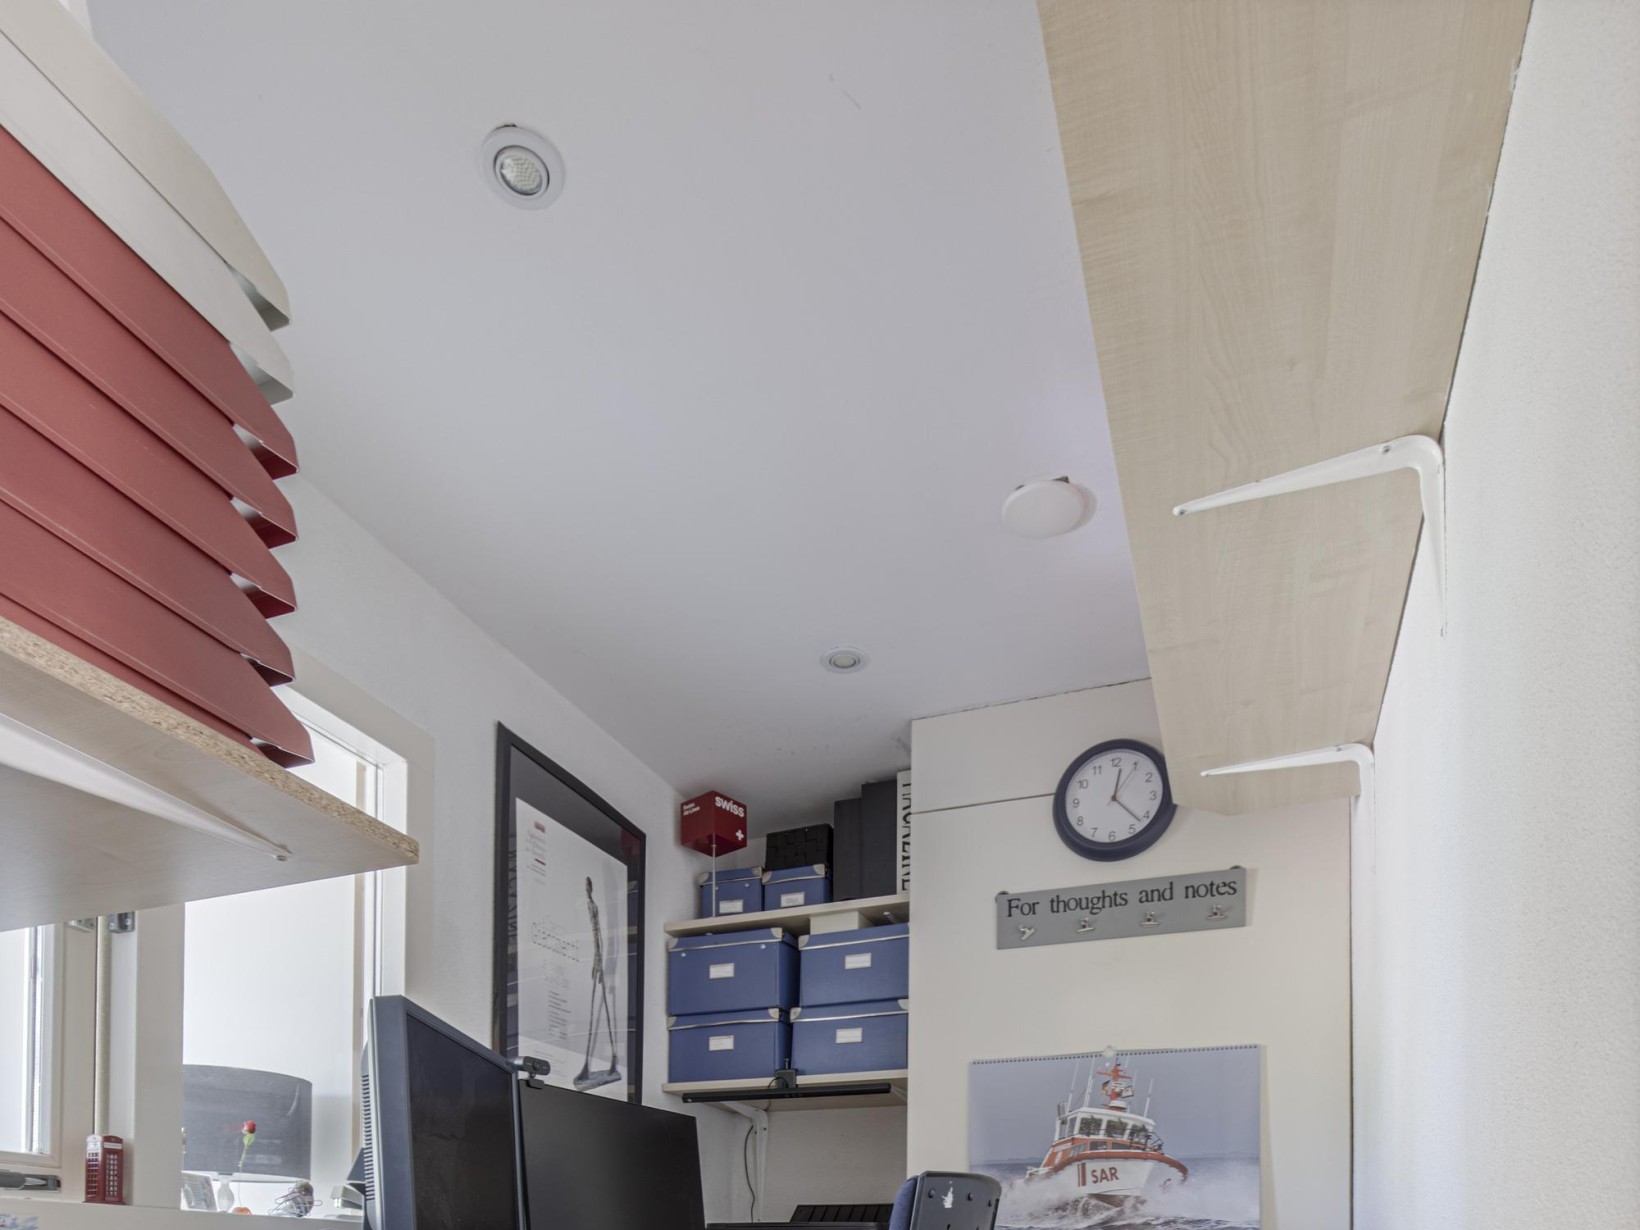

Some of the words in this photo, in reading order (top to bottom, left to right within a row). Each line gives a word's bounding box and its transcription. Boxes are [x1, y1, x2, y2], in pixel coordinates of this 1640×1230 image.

[1111, 757, 1122, 768] 12
[1133, 761, 1139, 771] 1
[1092, 765, 1102, 775] 11
[1145, 772, 1153, 783] 2
[1078, 779, 1088, 789] 10
[1149, 790, 1157, 801] 3
[714, 796, 745, 818] swiss
[1072, 798, 1080, 808] 9
[1143, 810, 1150, 820] 4
[1077, 816, 1084, 826] 8
[1091, 827, 1098, 838] 7
[1128, 824, 1136, 834] 5
[1108, 831, 1116, 841] 6
[1006, 898, 1040, 918] For
[1049, 890, 1128, 915] thoughts
[1138, 881, 1174, 905] and
[1184, 881, 1238, 901] notes
[1091, 1167, 1119, 1184] SAR
